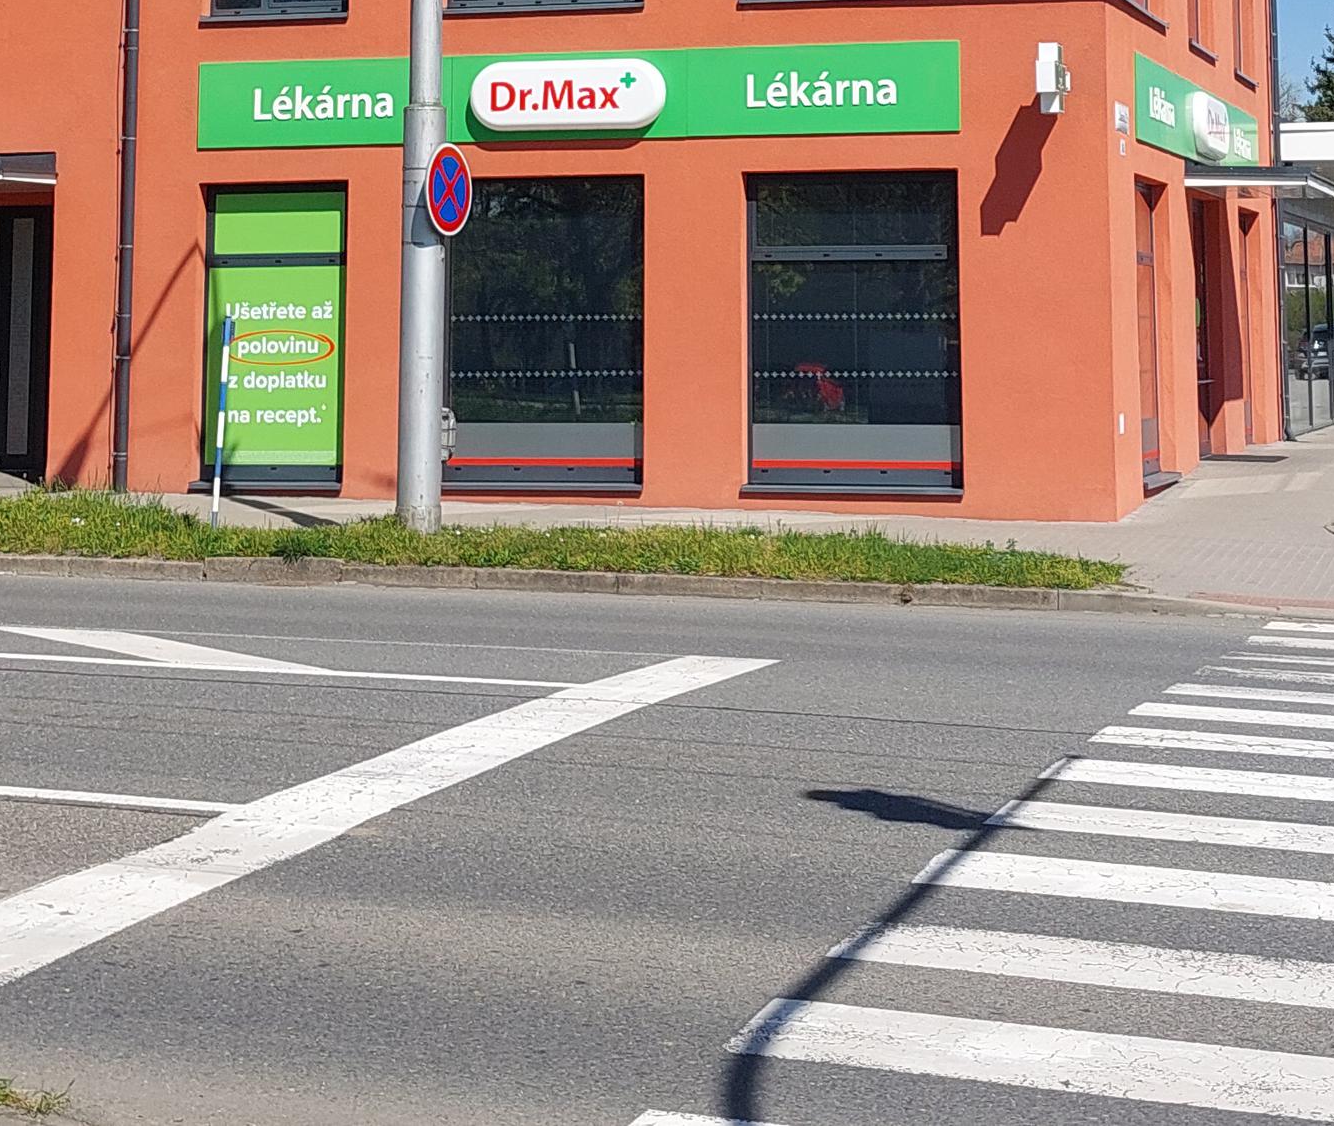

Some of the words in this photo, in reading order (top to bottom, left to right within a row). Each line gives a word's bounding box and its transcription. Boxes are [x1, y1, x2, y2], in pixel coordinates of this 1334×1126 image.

[490, 79, 620, 113] Dr.Max
[745, 71, 898, 109] Lékárna
[253, 88, 394, 122] Lékárna
[226, 301, 307, 320] Ušetřete
[311, 300, 333, 319] až
[237, 336, 319, 358] polovinu
[228, 375, 239, 389] z
[243, 371, 327, 393] doplatku
[227, 409, 250, 423] na
